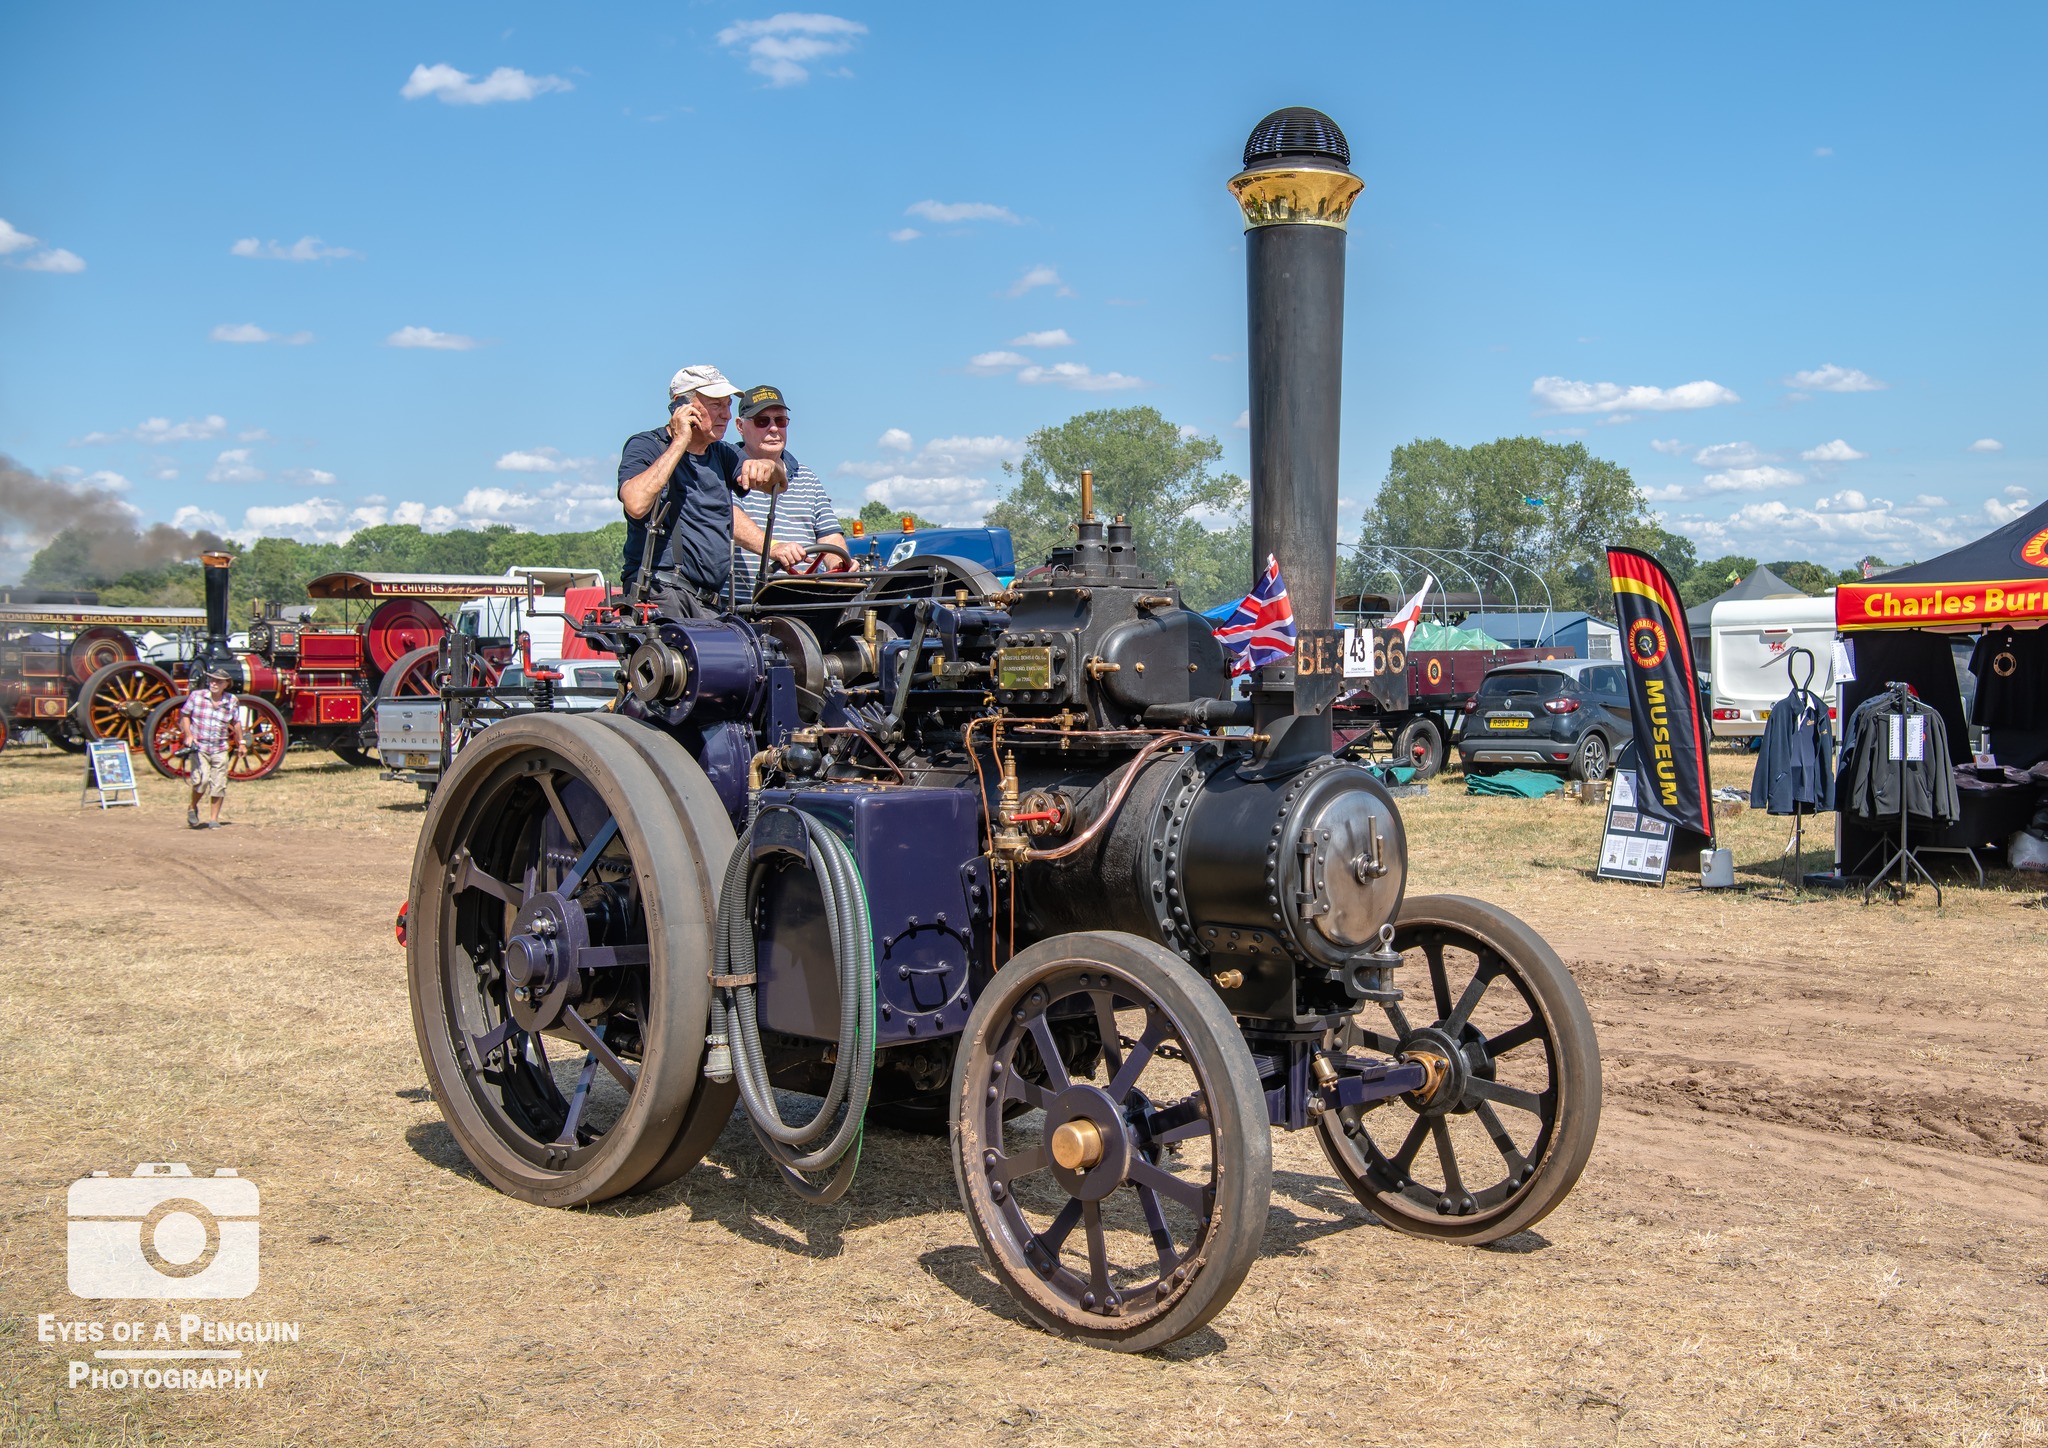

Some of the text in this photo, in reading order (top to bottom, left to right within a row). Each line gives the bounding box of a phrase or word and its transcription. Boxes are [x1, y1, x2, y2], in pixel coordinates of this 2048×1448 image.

[495, 585, 536, 594] DEVIZE
[1864, 589, 1976, 618] Charles
[81, 614, 134, 623] GIGANTIC
[1350, 638, 1366, 663] 43
[1654, 626, 1666, 652] MUSEUM
[1492, 719, 1525, 727] R900 TJS
[1645, 680, 1678, 806] MUSEUM
